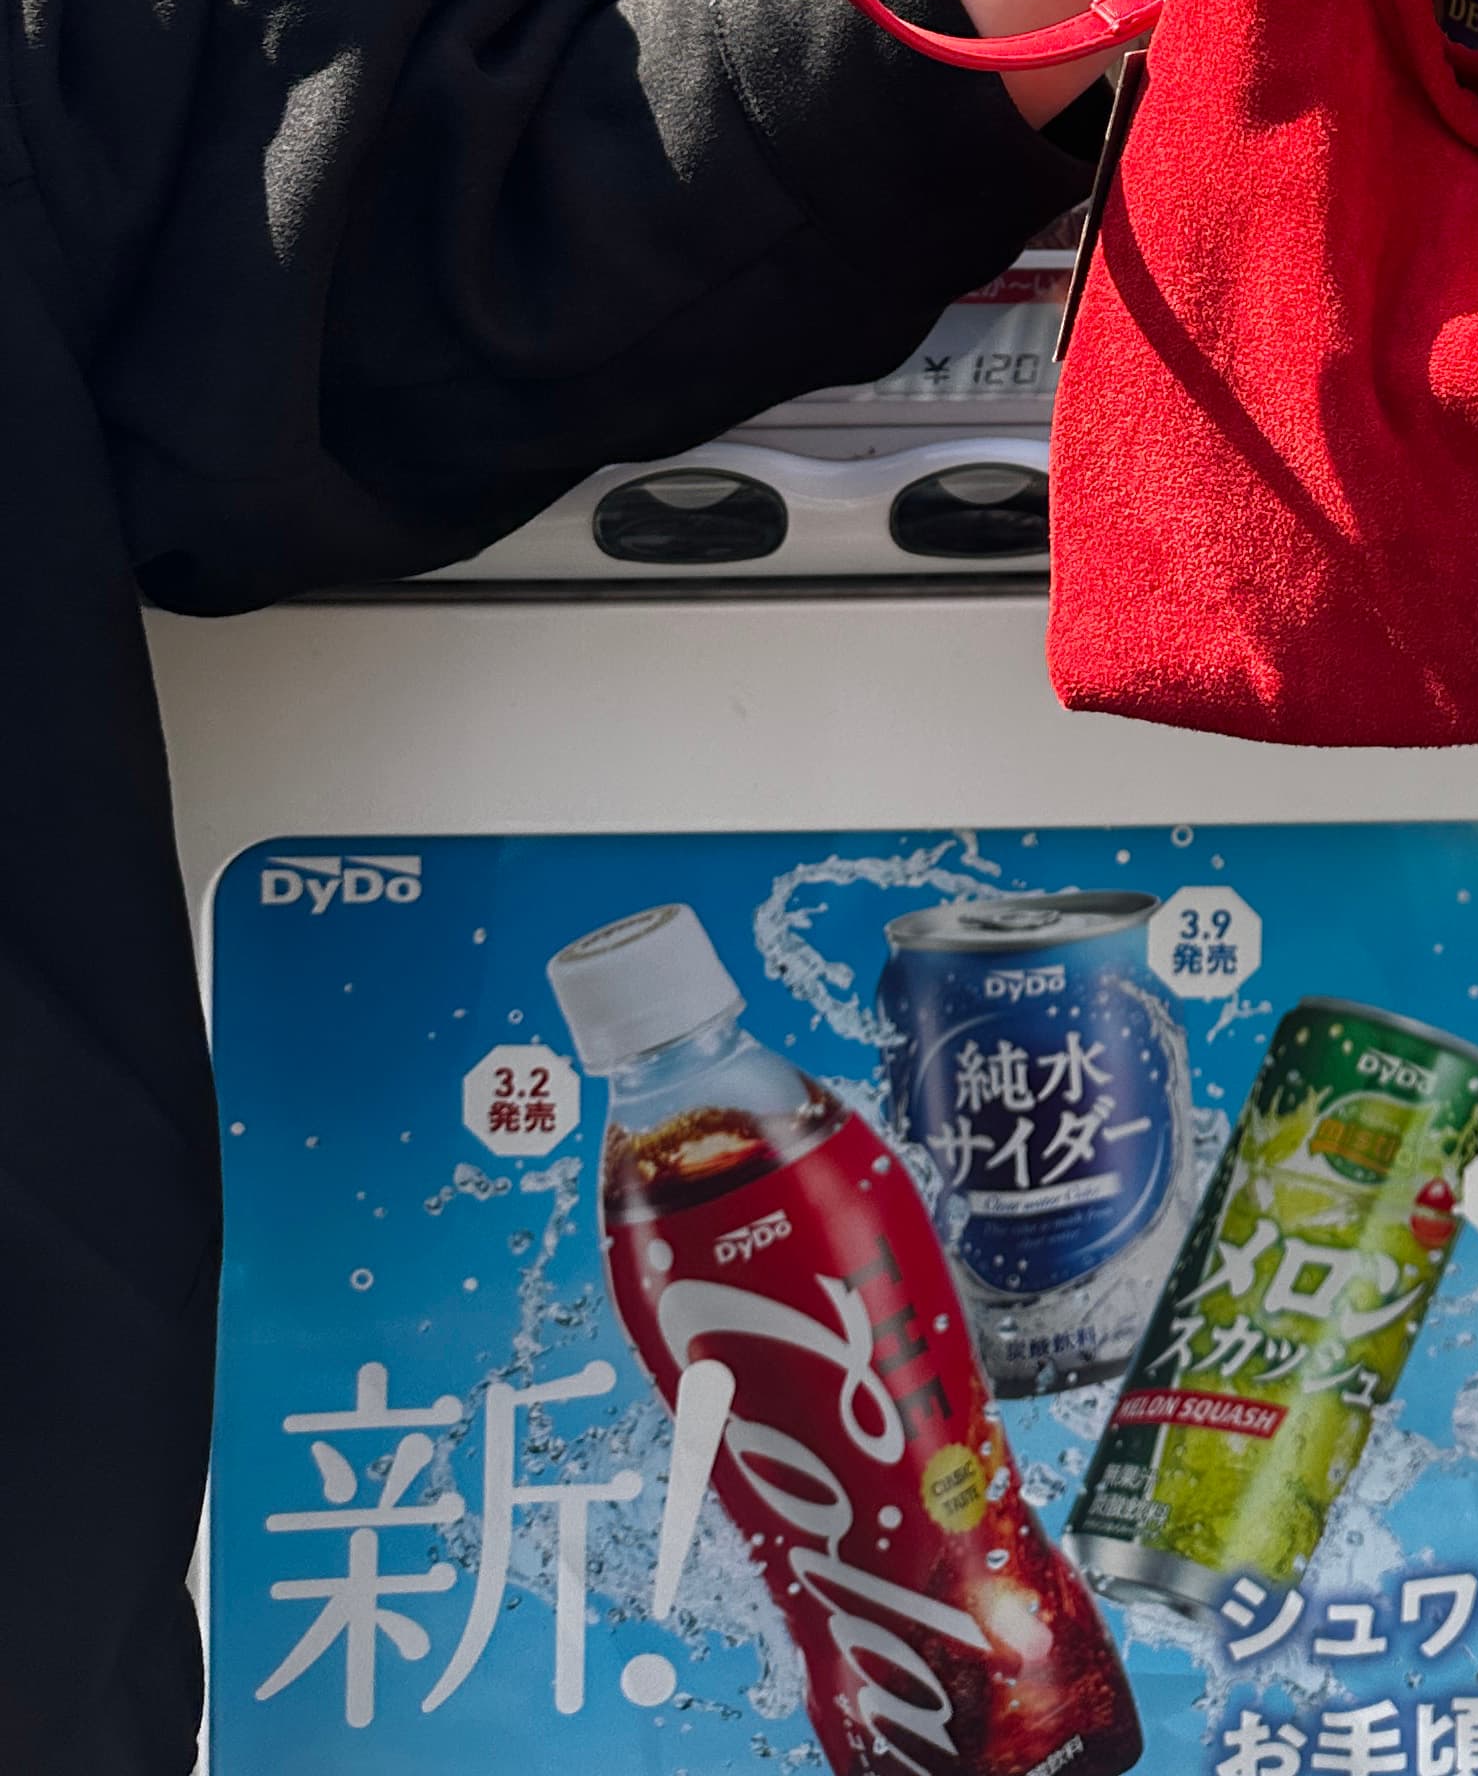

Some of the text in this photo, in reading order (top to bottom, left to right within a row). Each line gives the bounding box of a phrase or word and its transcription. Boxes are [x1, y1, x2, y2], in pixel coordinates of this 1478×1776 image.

[261, 856, 422, 915] DyDo
[1180, 910, 1231, 942] 3.9
[985, 965, 1065, 1003] DyDo
[1172, 944, 1238, 976] 発売
[494, 1067, 551, 1100] 3.2
[955, 1032, 1113, 1113] 純水
[488, 1100, 556, 1135] 発売
[927, 1098, 1152, 1190] サイダー
[716, 1210, 792, 1266] DyDo
[1176, 1217, 1427, 1340] メロン
[1146, 1315, 1383, 1409] スカッシュ
[1117, 1393, 1279, 1434] MELON SQUASH
